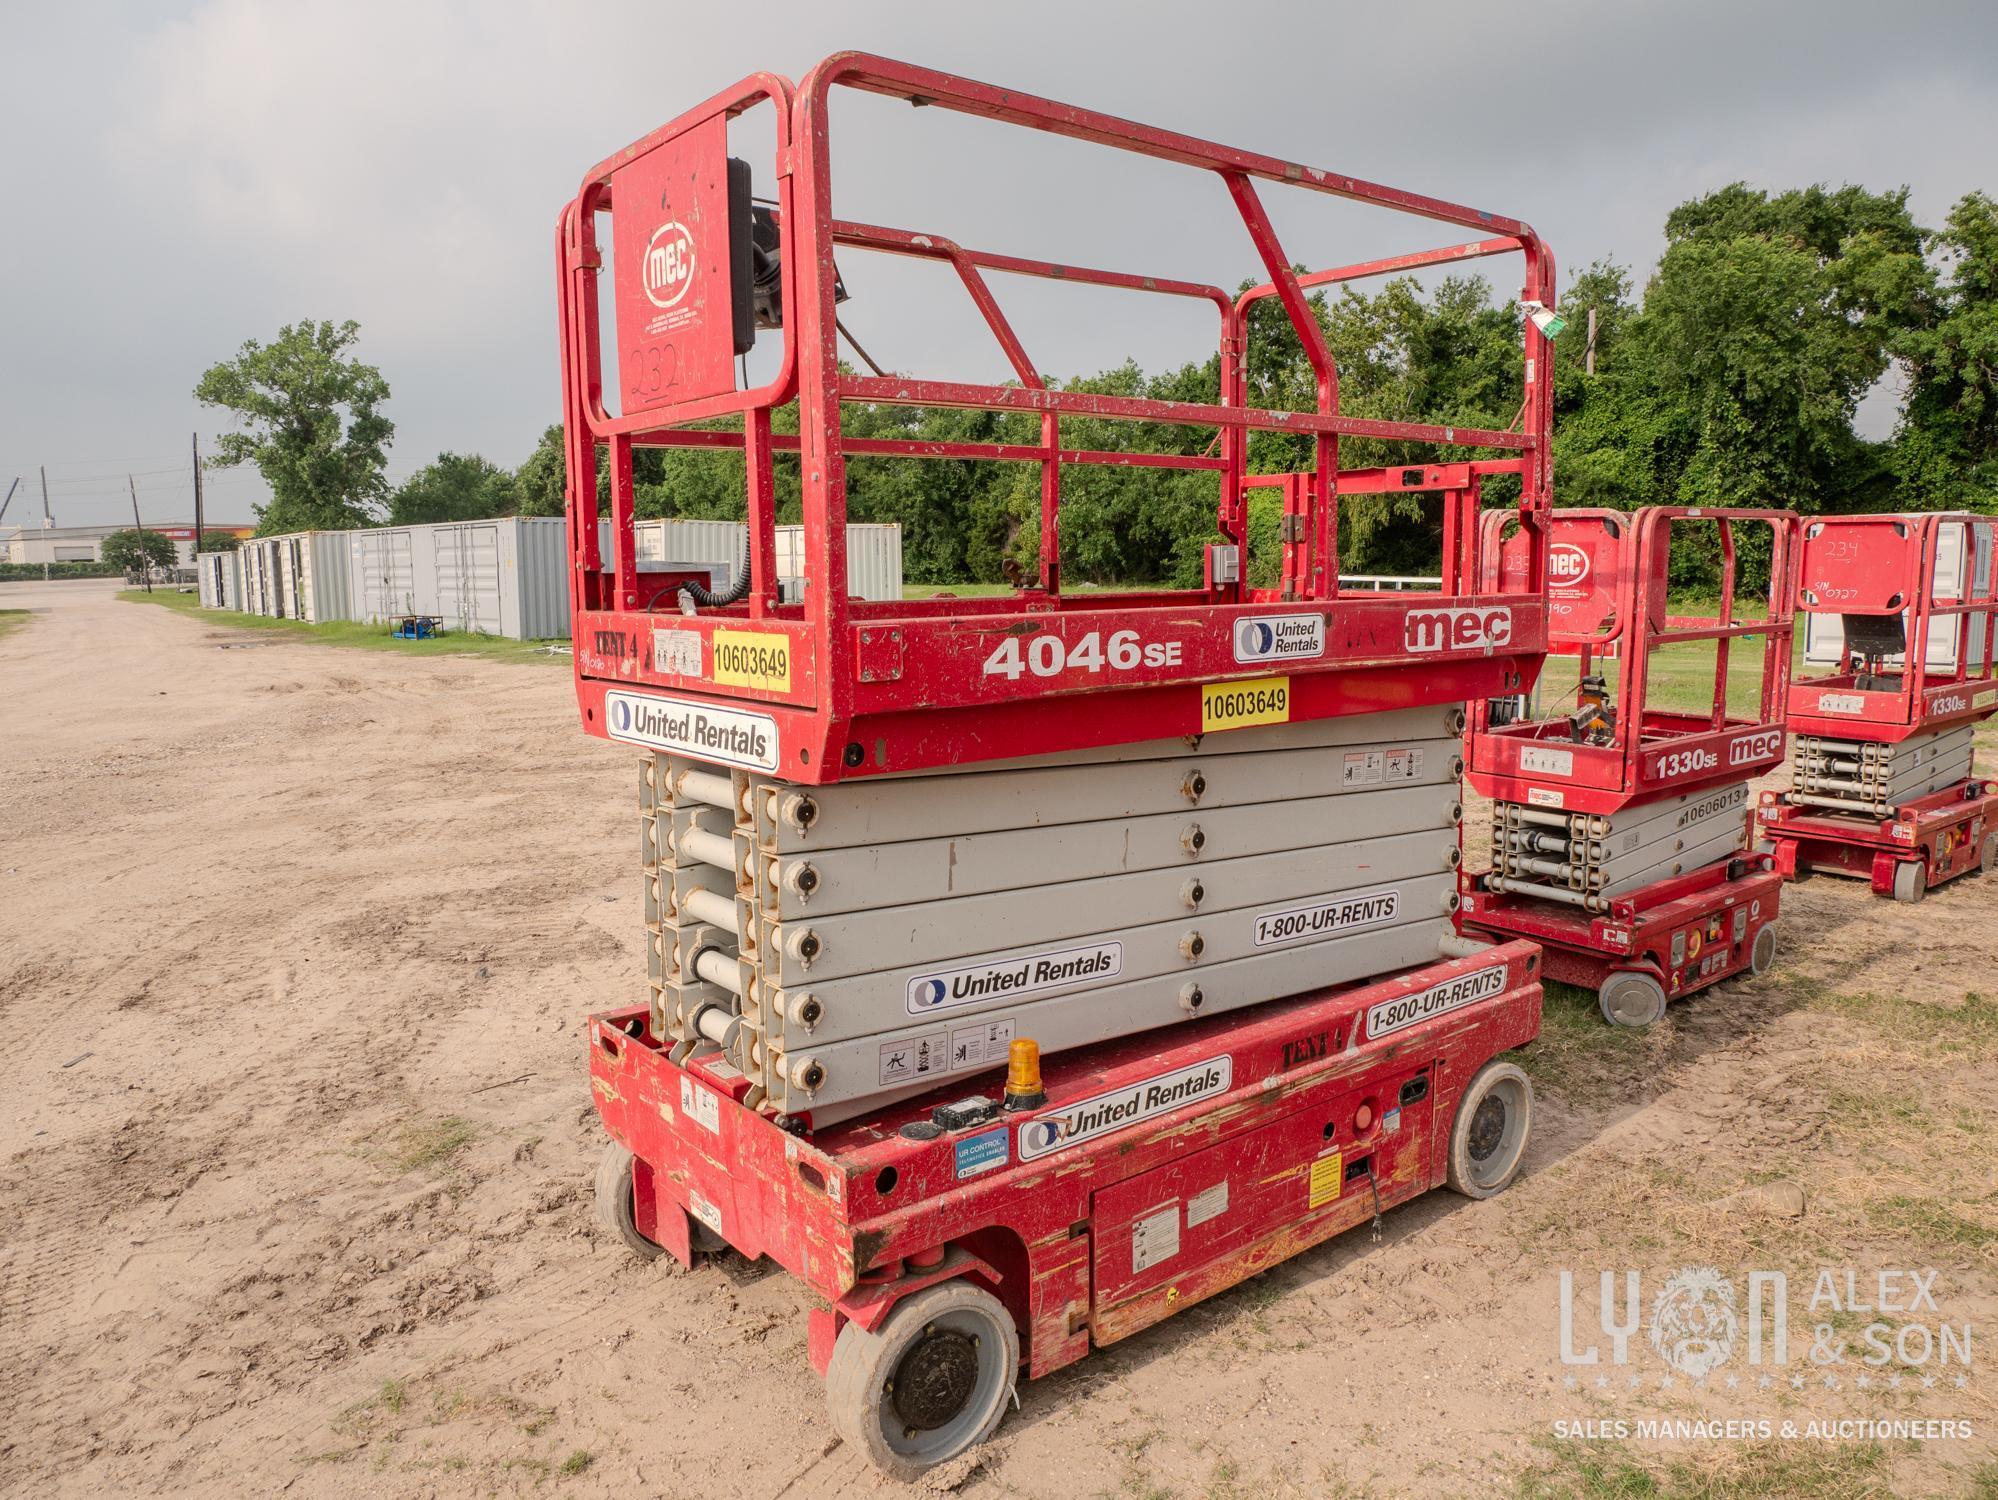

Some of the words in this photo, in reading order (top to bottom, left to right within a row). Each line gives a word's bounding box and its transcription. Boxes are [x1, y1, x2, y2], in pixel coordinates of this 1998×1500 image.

[650, 238, 688, 290] mec
[630, 343, 679, 396] 232
[1825, 541, 1859, 557] 234
[1814, 581, 1830, 591] S/N
[1825, 589, 1858, 600] 0327
[1275, 620, 1316, 637] United
[1407, 607, 1510, 648] mec
[594, 630, 627, 658] TENT
[629, 632, 638, 658] 4
[714, 643, 787, 677] 10603649
[1275, 636, 1319, 653] Rentals
[1203, 687, 1286, 719] 10603649
[634, 704, 691, 742] United
[694, 714, 767, 758] Rentals
[1732, 731, 1781, 762] mec
[1656, 748, 1718, 779] 1330SE
[1684, 790, 1741, 822] 10606013
[1258, 896, 1396, 942] 1-800-UR-RENTS
[951, 963, 1029, 1000] United
[1034, 950, 1113, 984] Rentals
[1372, 968, 1504, 1033] 1-800-UR-RENTS
[1065, 1096, 1141, 1138] United
[1144, 1067, 1221, 1111] Rentals
[958, 1149, 969, 1158] UR
[969, 1138, 1001, 1154] CONTROL
